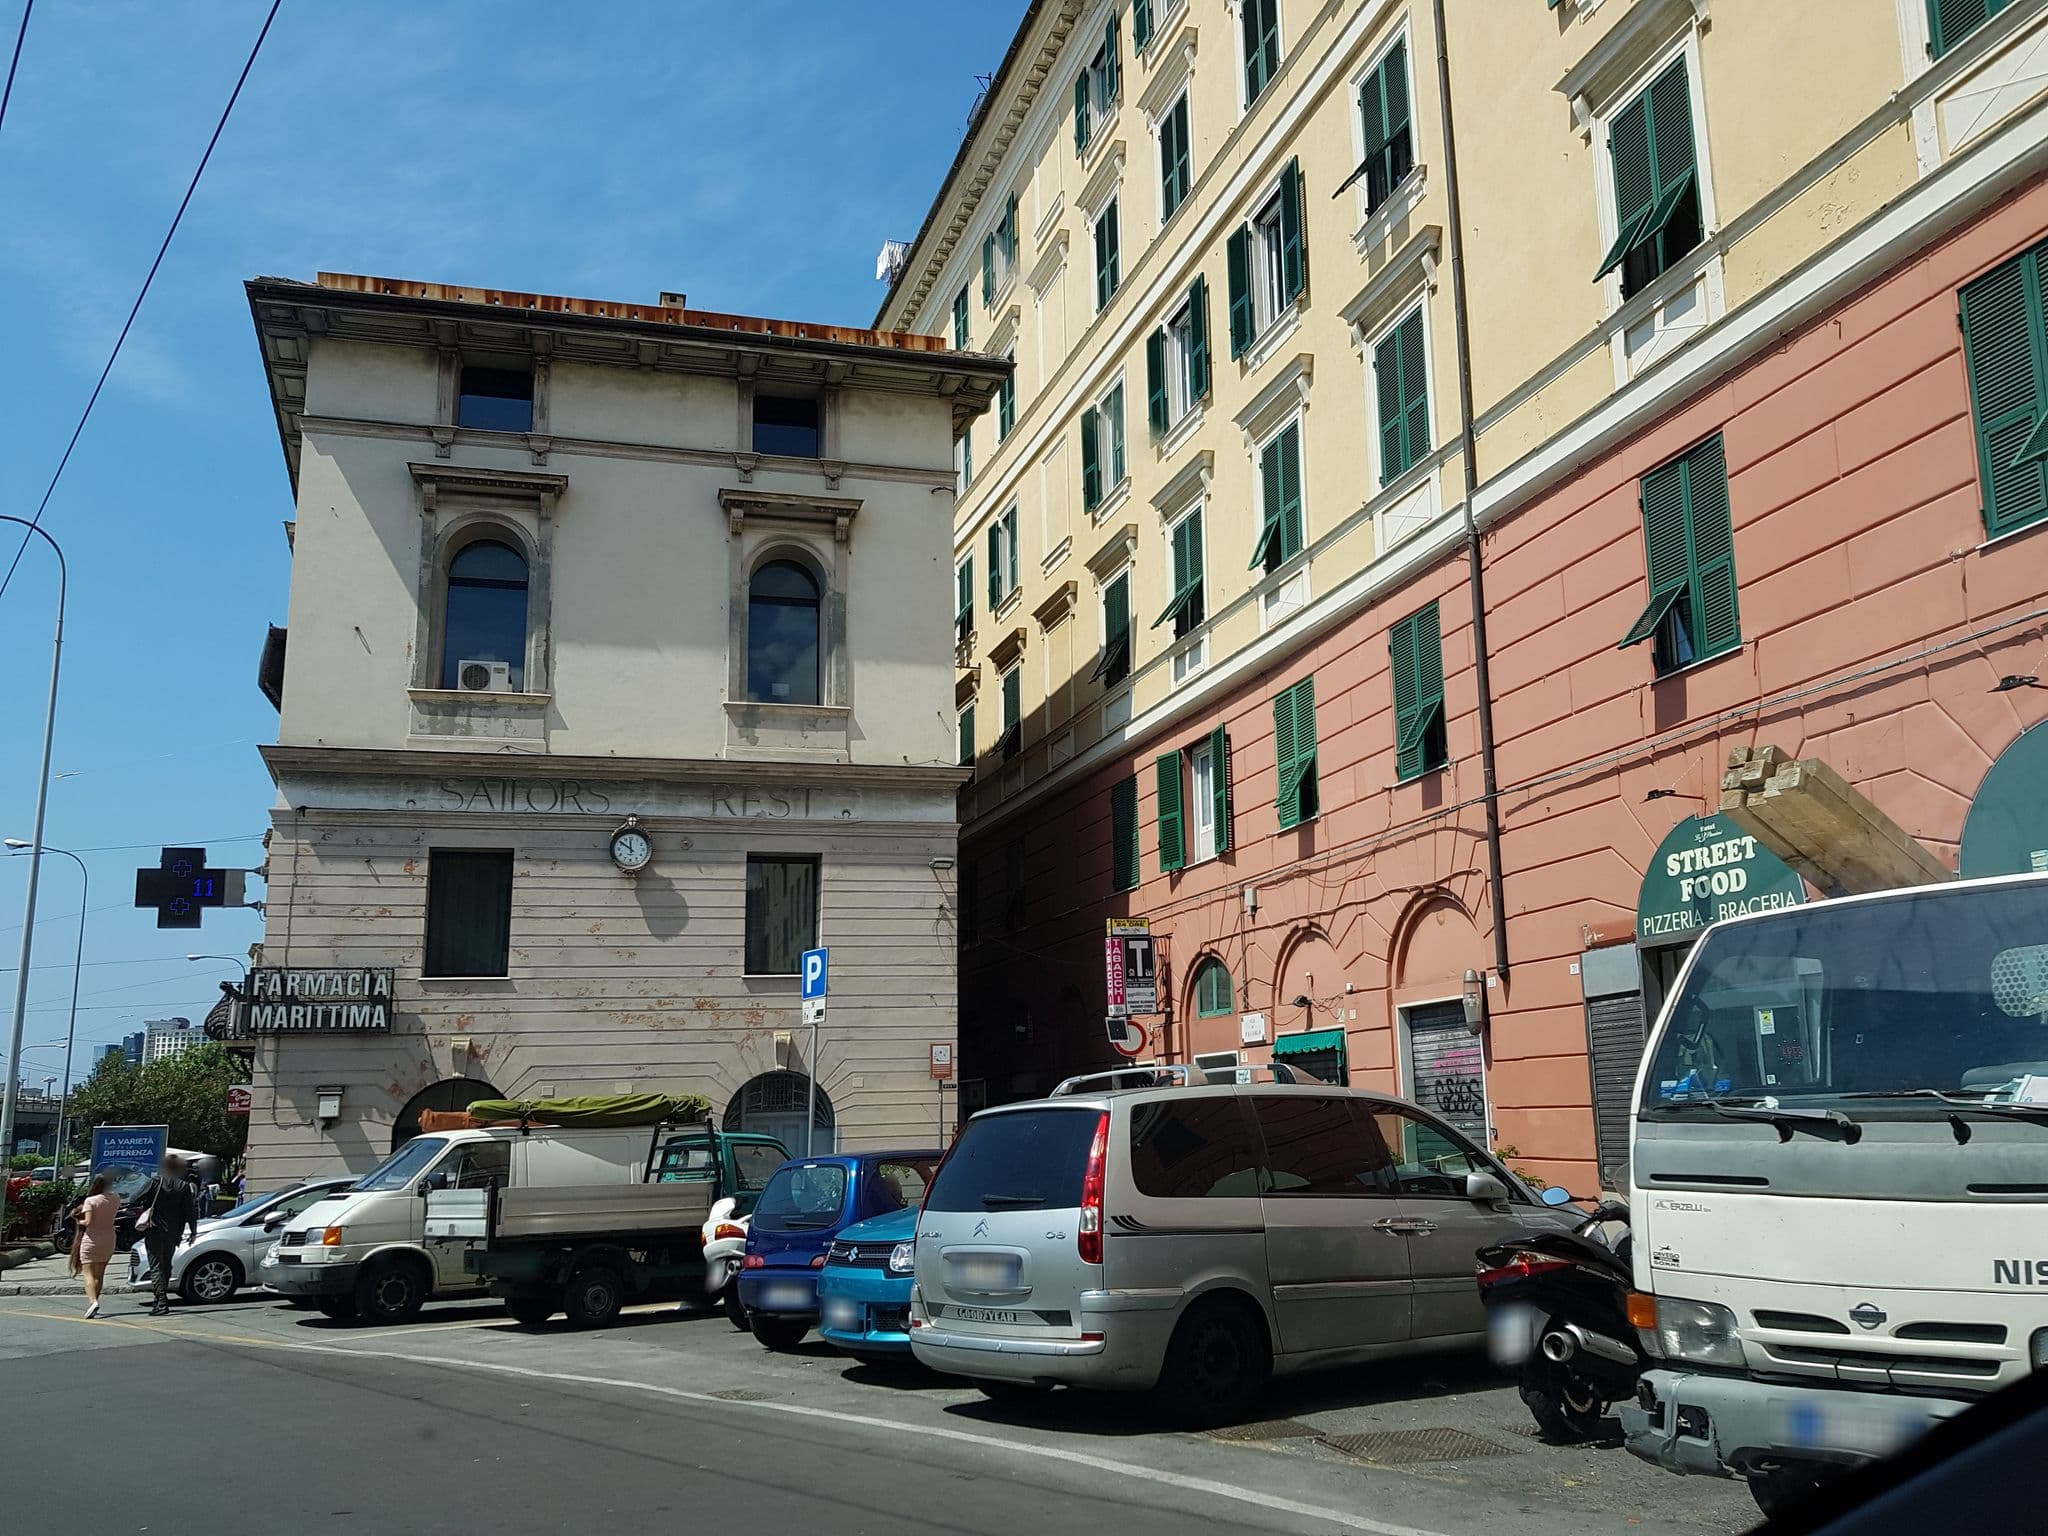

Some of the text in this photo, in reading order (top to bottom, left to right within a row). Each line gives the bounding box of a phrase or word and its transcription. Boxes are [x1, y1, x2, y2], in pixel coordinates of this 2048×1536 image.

[440, 778, 823, 818] SAILORS REST
[1666, 835, 1758, 877] STREET
[192, 879, 213, 897] 11
[1680, 868, 1748, 902] FOOD
[1643, 908, 1704, 936] PIZZERIA
[1718, 890, 1797, 921] BRACERIA
[806, 954, 822, 994] P
[1112, 938, 1123, 1004] TABACCHI
[1128, 940, 1149, 977] T
[253, 973, 388, 996] FARMACIA
[250, 1004, 386, 1029] MARITTIMA
[103, 1149, 154, 1157] DIFFERENZA
[118, 1135, 154, 1145] VARIETÀ
[957, 1308, 1016, 1323] GOODYEAR
